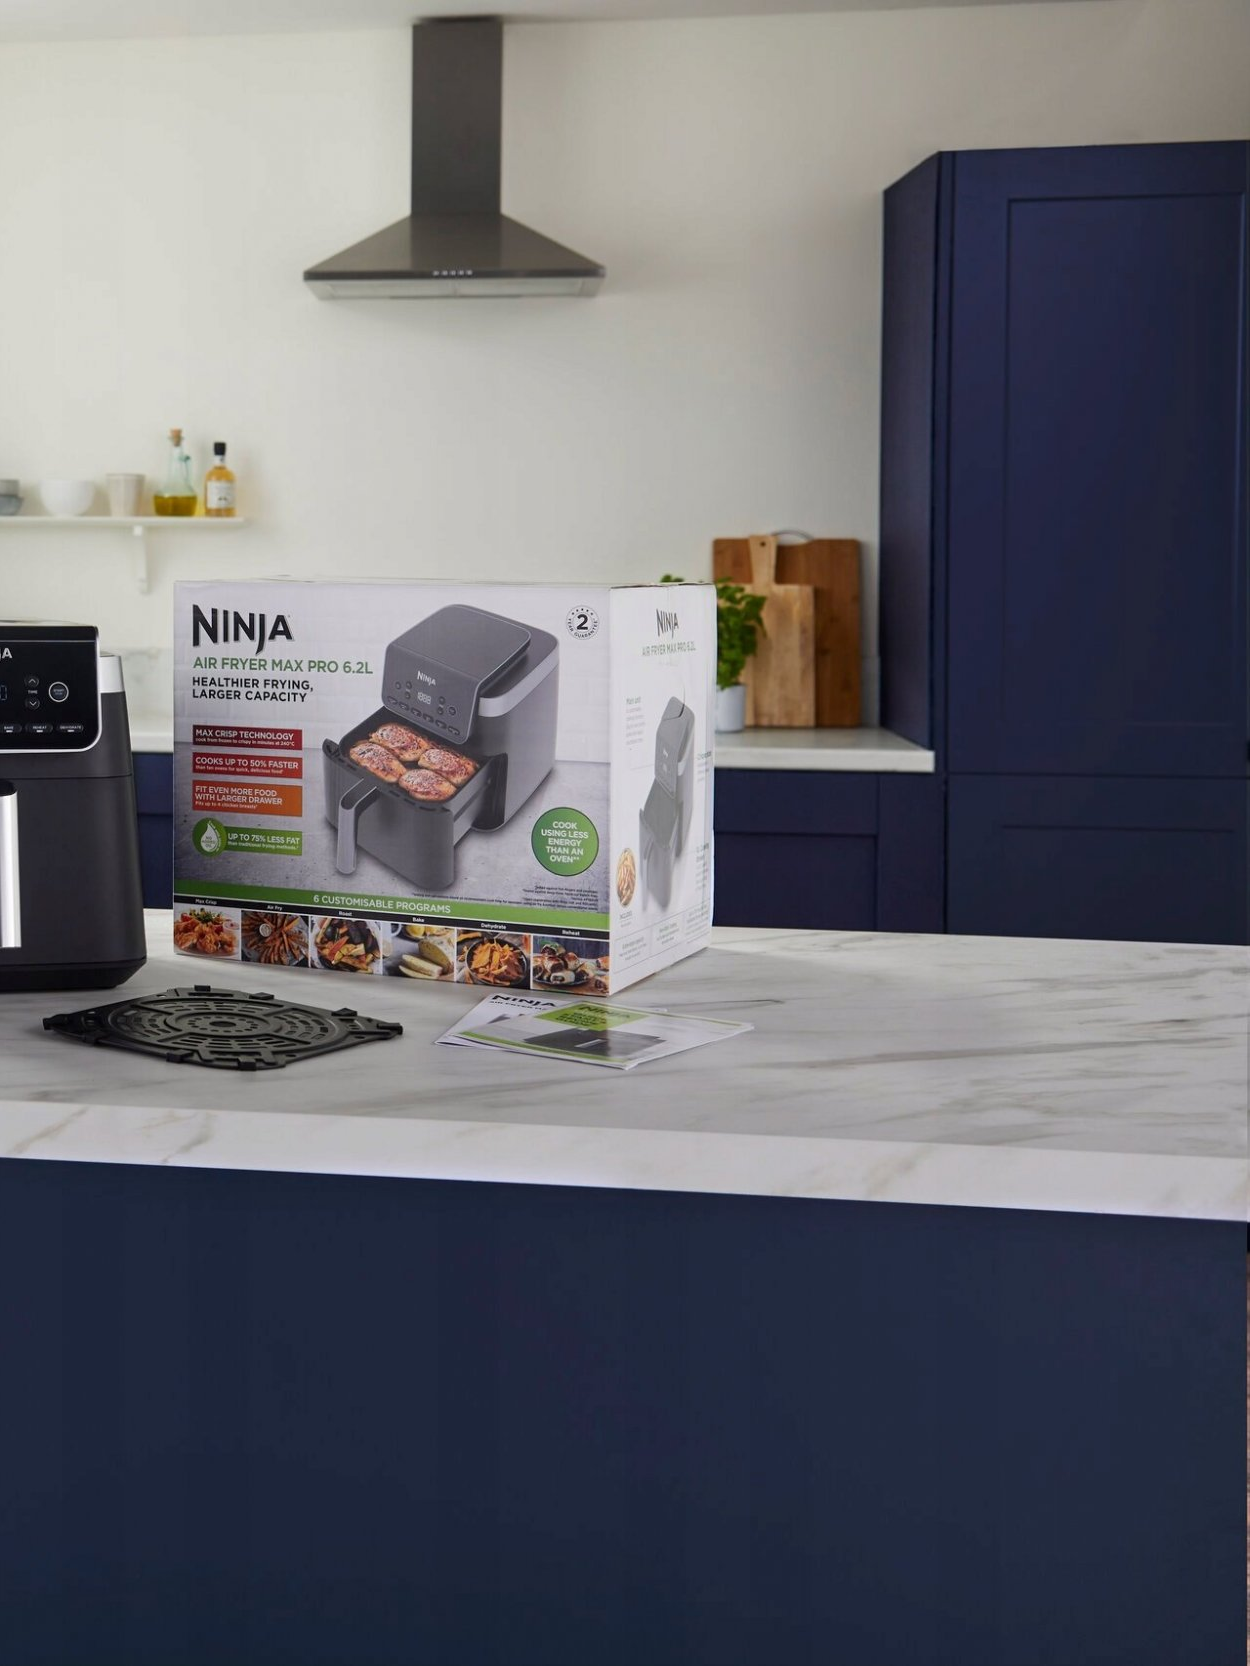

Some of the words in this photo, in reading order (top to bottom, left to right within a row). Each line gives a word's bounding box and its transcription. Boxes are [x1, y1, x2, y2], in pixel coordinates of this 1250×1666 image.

[576, 614, 588, 630] 2
[656, 608, 679, 639] NINJA
[192, 604, 293, 656] NINJA
[193, 656, 218, 670] AIR
[222, 657, 267, 670] FRYER
[272, 659, 304, 672] MAX
[308, 660, 338, 673] PRO
[343, 661, 373, 674] 6.2L
[192, 677, 259, 688] HEALTHIER
[264, 680, 313, 691] FRYING,
[417, 670, 436, 686] NINJA
[192, 690, 241, 700] LARGER
[245, 691, 307, 702] CAPACITY
[239, 731, 294, 740] TECHNOLOGY
[196, 757, 223, 765] COOKS
[268, 761, 298, 769] FASTER
[217, 794, 247, 802] LARGER
[248, 797, 283, 805] DRAWER
[552, 821, 578, 829] COOK
[541, 829, 567, 837] USING
[548, 838, 582, 846] ENERGY
[546, 846, 569, 854] THAN
[313, 894, 319, 902] 6
[322, 896, 394, 909] CUSTOMISABLE
[396, 902, 451, 913] PROGRAMS
[492, 995, 556, 1007] NINJA
